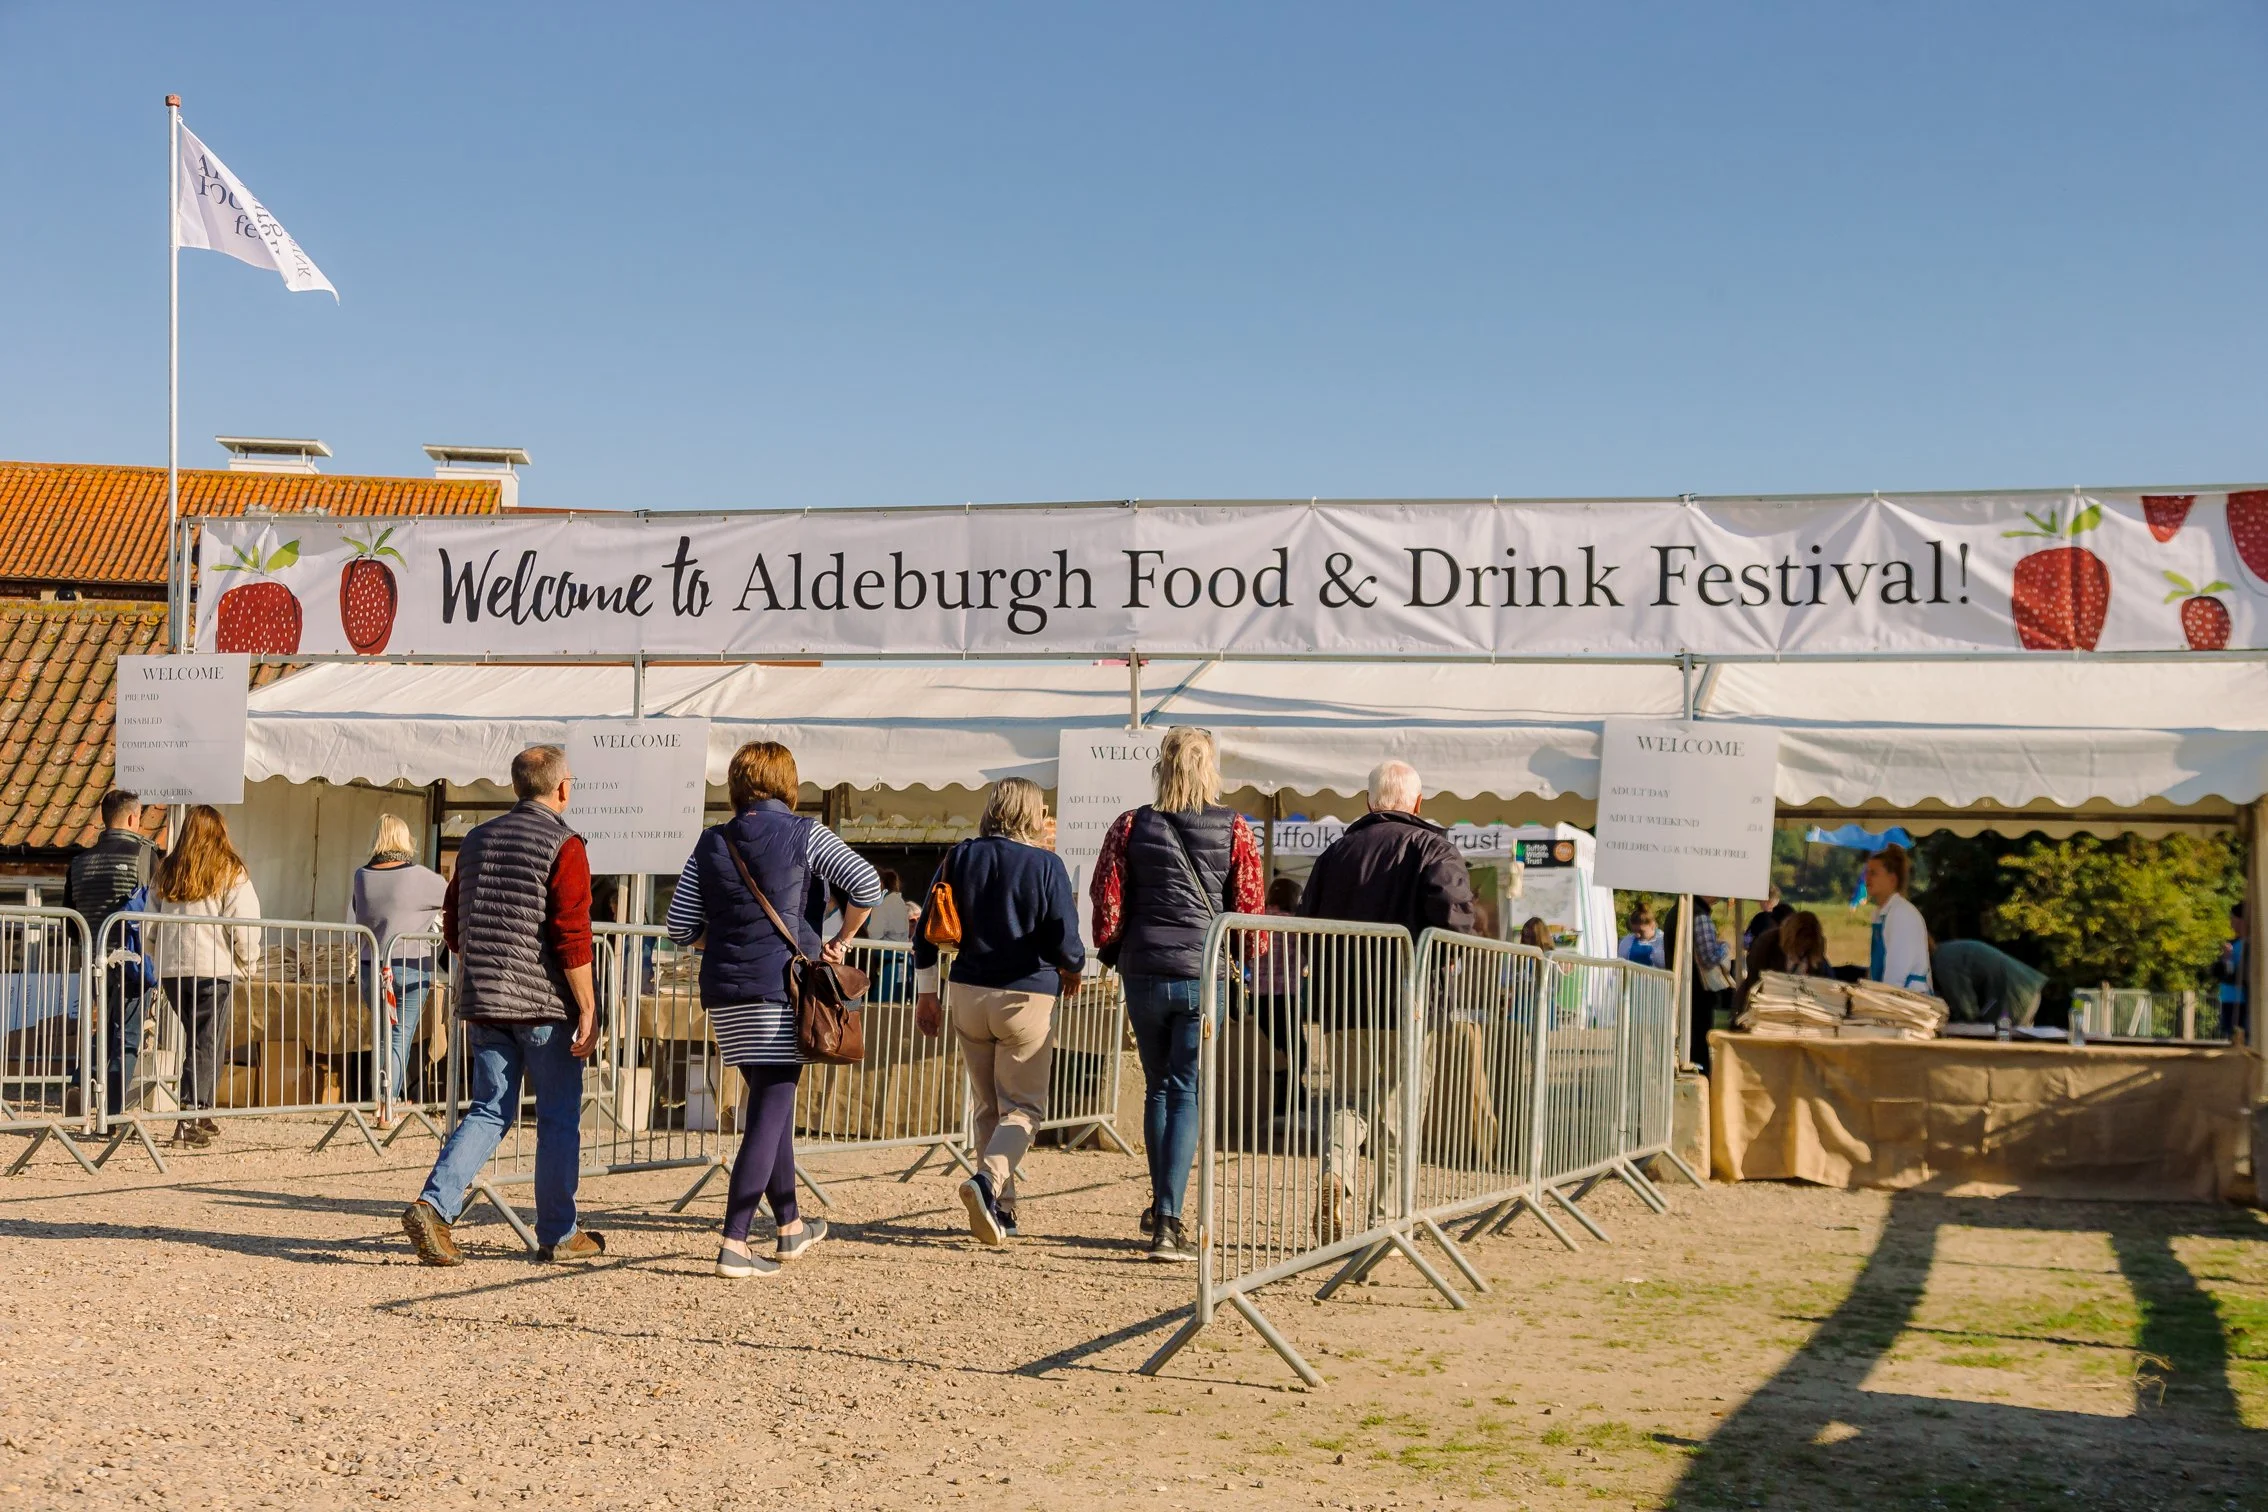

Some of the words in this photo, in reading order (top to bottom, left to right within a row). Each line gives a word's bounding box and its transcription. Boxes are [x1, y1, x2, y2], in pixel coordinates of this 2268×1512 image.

[439, 547, 654, 626] Welcome
[662, 536, 712, 618] to
[732, 549, 1098, 635] Aldeburgh
[1121, 546, 1294, 609] Food
[1318, 551, 1379, 609] &
[1404, 545, 1625, 609] Drink
[1650, 539, 1972, 609] Festival!
[143, 666, 224, 681] WELCOME
[125, 694, 138, 702] PRE
[140, 693, 159, 701] PAID
[124, 717, 163, 726] DISABLED
[122, 740, 190, 749] COMPLIMENTARY
[593, 733, 681, 749] WELCOME
[1636, 735, 1745, 757] WELCOME
[1091, 746, 1160, 761] WELCO
[123, 765, 145, 773] PRESS
[571, 782, 600, 790] ADULT
[602, 782, 619, 790] DAY
[160, 788, 193, 797] QUERIES
[1610, 786, 1648, 797] ADULT
[1649, 788, 1670, 798] DAY
[1067, 796, 1100, 804] ADULT
[1102, 796, 1122, 804] DAY
[569, 807, 599, 815] ADULT
[600, 806, 644, 815] WEEKEND
[1608, 813, 1643, 825] ADULT
[1646, 816, 1700, 828] WEEKEND
[1067, 822, 1099, 830] ADULT
[580, 831, 611, 840] ILDREN
[622, 831, 629, 839] &
[631, 831, 660, 839] UNDER
[663, 831, 685, 839] FREE
[1254, 825, 1336, 849] Suffolk
[1065, 847, 1101, 856] CHILDR
[1606, 840, 1660, 853] CHILDREN
[1683, 846, 1721, 857] UNDER
[1723, 849, 1750, 860] FREE
